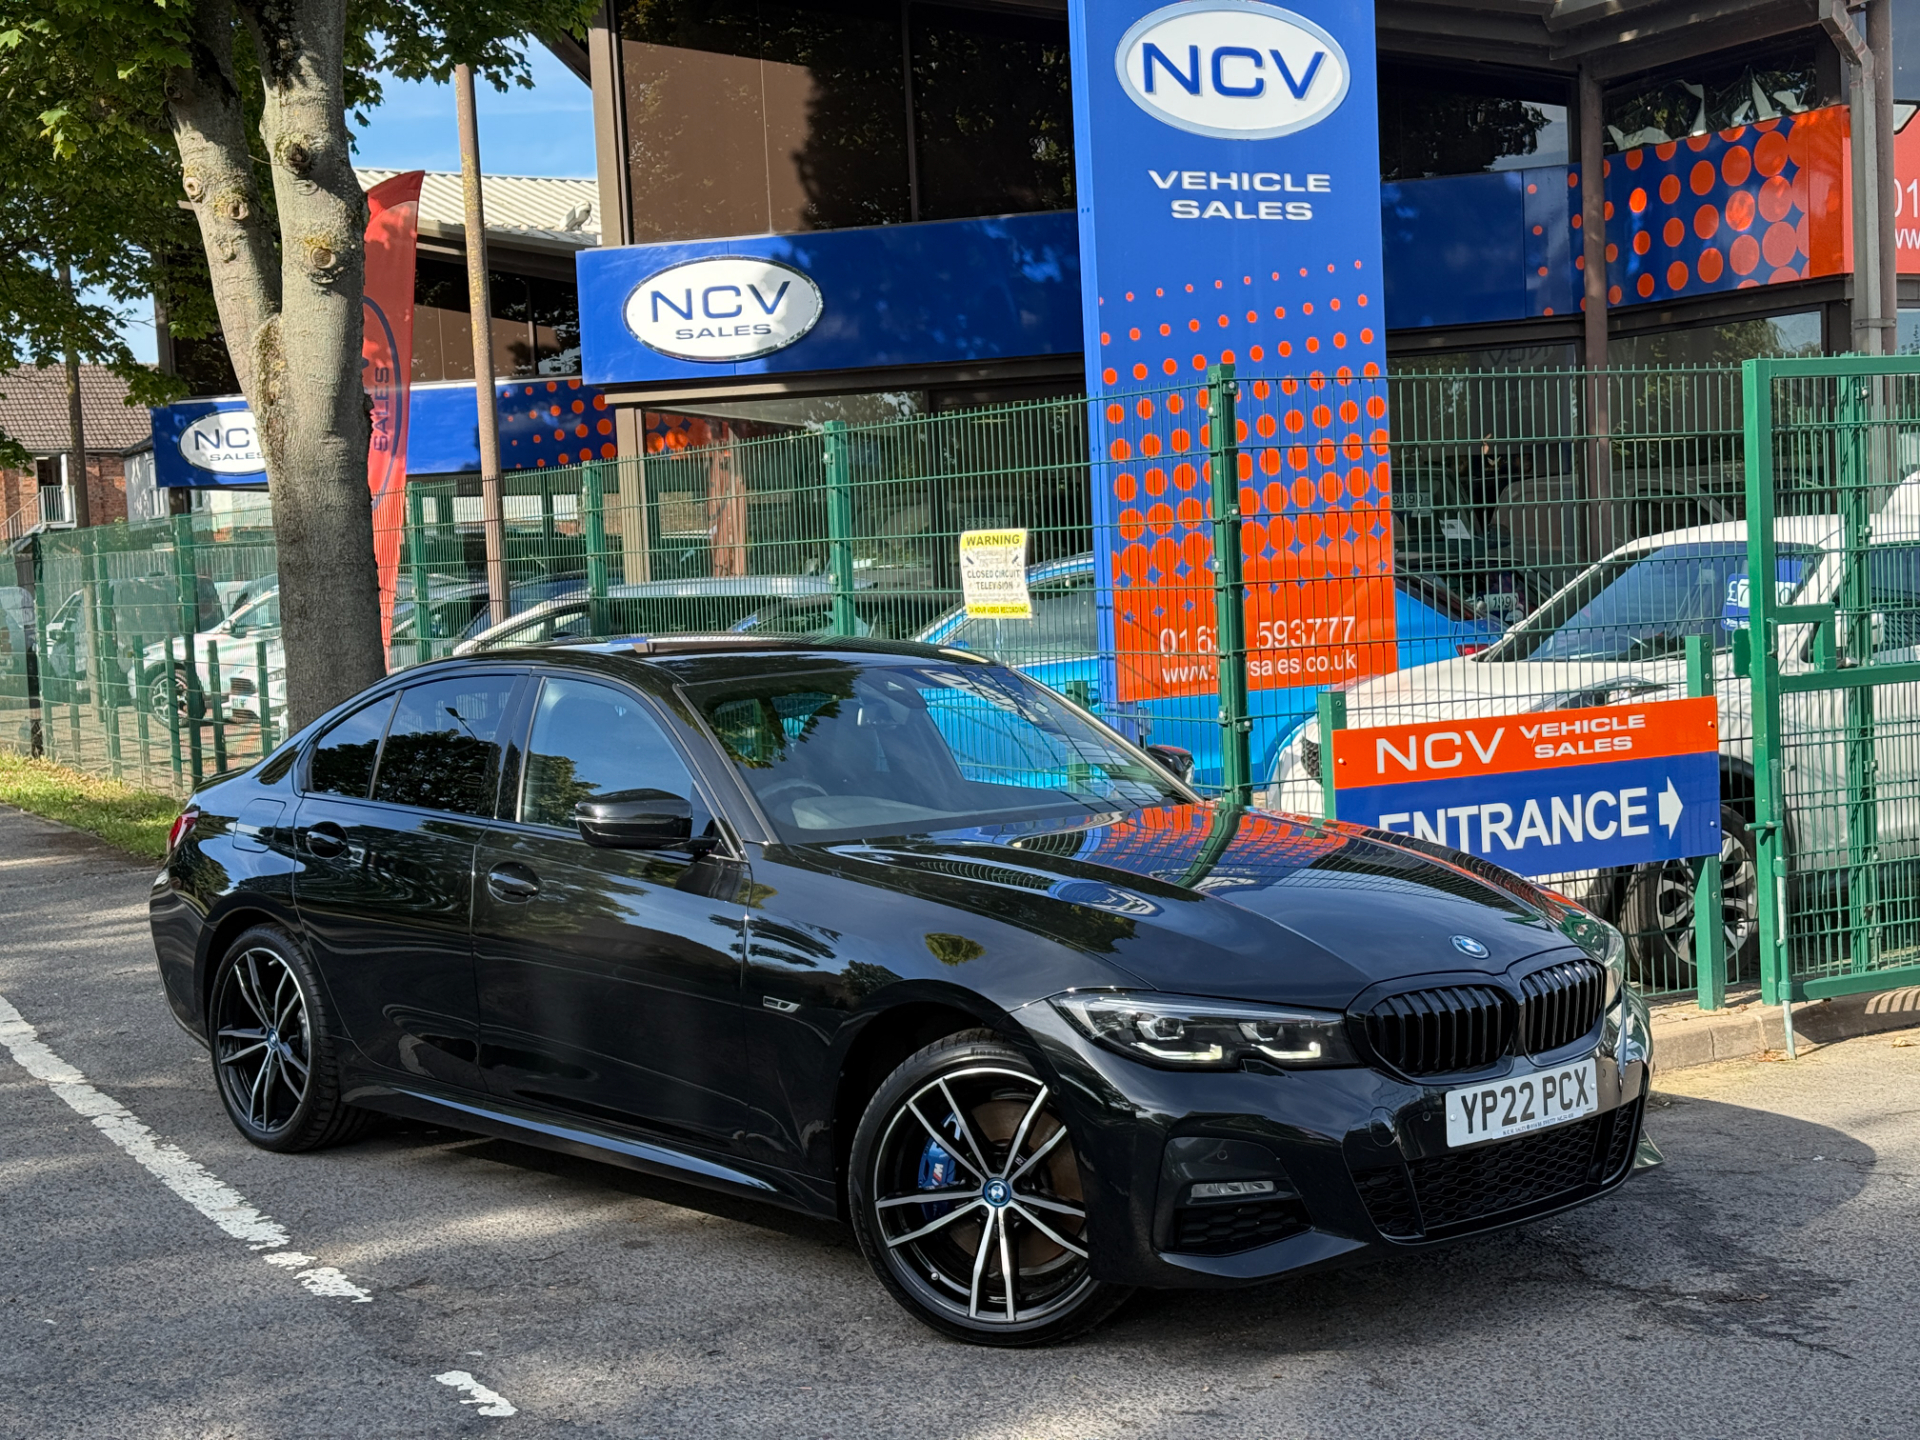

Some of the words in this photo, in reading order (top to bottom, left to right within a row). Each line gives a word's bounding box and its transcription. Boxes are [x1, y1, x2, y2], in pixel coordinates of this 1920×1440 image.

[1142, 42, 1326, 100] NCV
[1148, 169, 1332, 193] VEHICLE
[1170, 199, 1313, 221] SALES
[651, 280, 791, 323] NCV
[675, 323, 772, 340] SALES
[374, 366, 390, 453] SALES
[194, 427, 257, 451] NC
[966, 534, 1020, 547] WARNING
[967, 569, 993, 579] CLOSED
[994, 569, 1020, 579] CIRCUIT
[1256, 615, 1356, 649] 593777
[1376, 727, 1505, 774] NCV
[1519, 714, 1646, 739] VEHICLE
[1534, 735, 1633, 759] SALES
[1460, 1081, 1536, 1135] YP22
[1541, 1066, 1590, 1117] PCX
